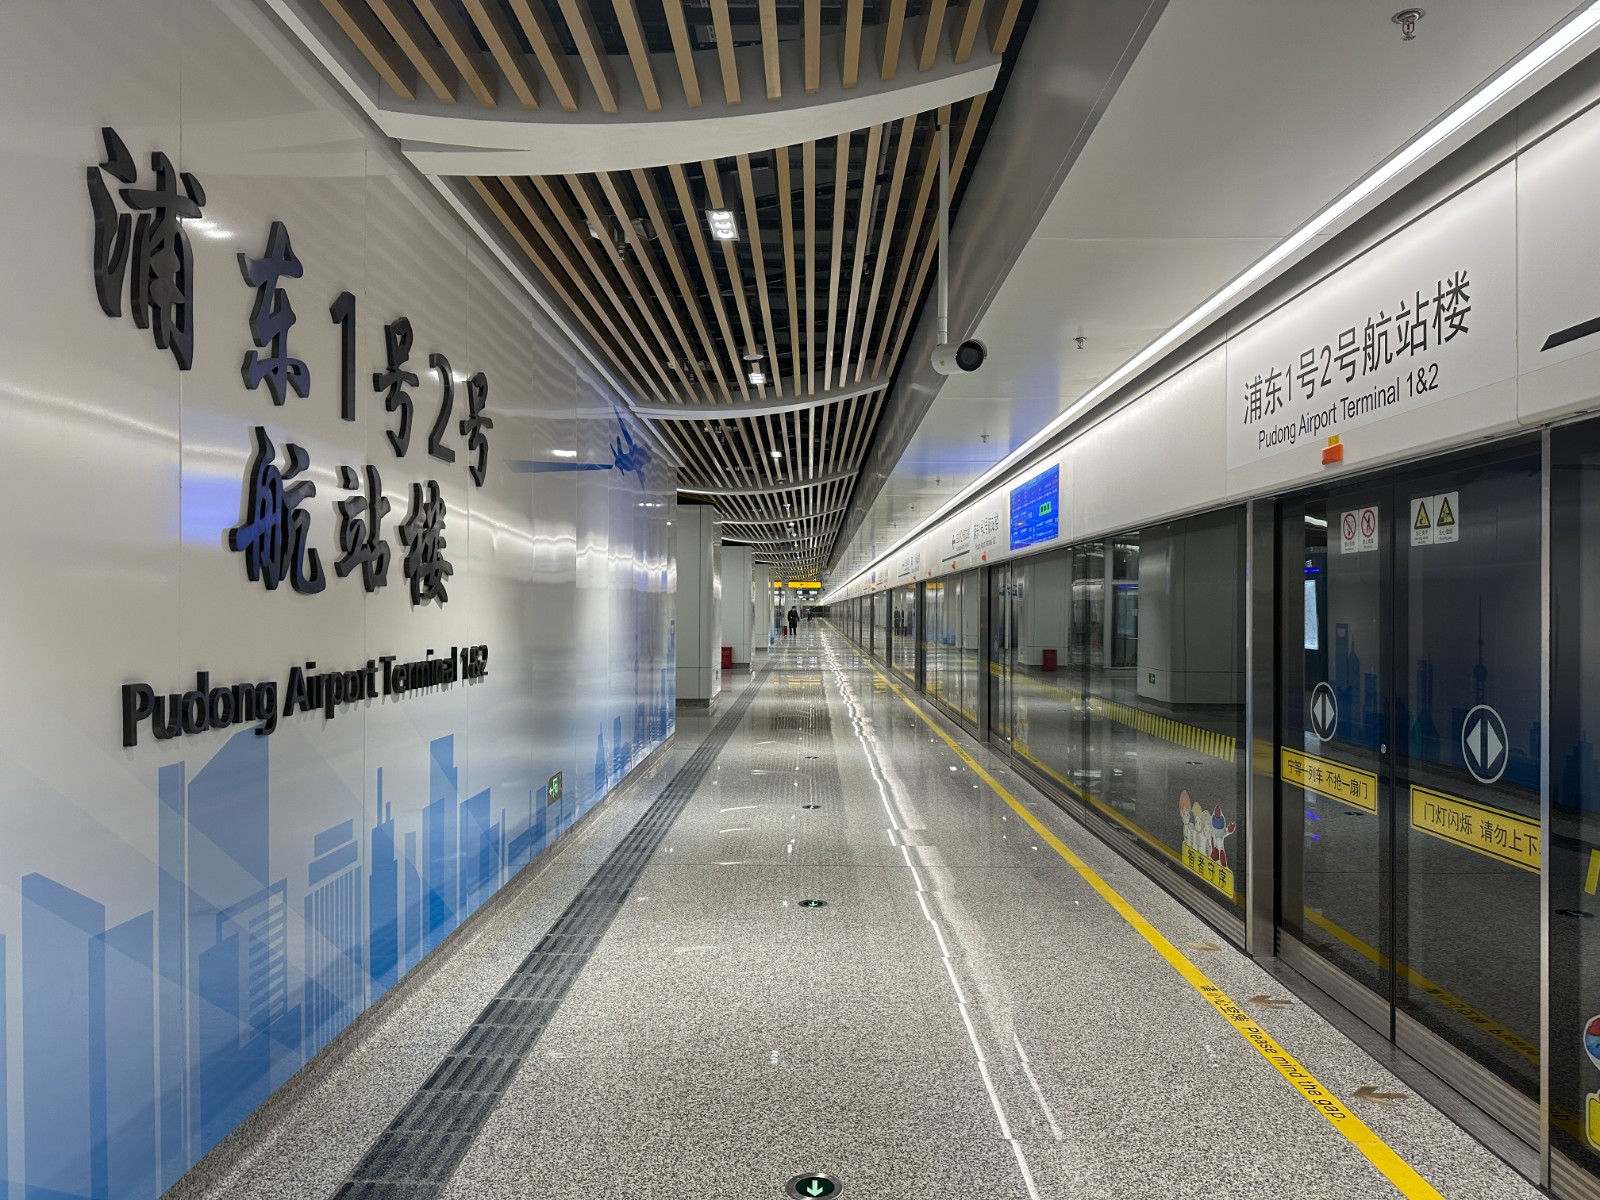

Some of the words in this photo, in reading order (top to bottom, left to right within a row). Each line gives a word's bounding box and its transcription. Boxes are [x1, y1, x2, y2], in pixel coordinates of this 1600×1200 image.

[87, 127, 494, 487] 浦东1号2号
[1243, 270, 1472, 424] 浦东1号2号航站楼
[1258, 424, 1296, 450] Pudong
[1298, 402, 1337, 437] Airport
[1340, 376, 1400, 421] Terminal
[1406, 362, 1439, 398] 1&2
[229, 426, 454, 606] 航站楼
[122, 671, 278, 747] Pudong
[283, 661, 379, 719] Airport
[379, 648, 458, 695] Terminal
[460, 645, 489, 680] 1&2
[1287, 759, 1324, 784] 宁等一列车
[1325, 770, 1368, 800] 不抢一扇门
[1188, 848, 1227, 889] 智者守序
[1423, 801, 1473, 836] 门灯闪烁
[1480, 818, 1541, 857] 请勿上下
[1242, 1026, 1278, 1054] Please
[1272, 1055, 1308, 1079] mind
[1297, 1080, 1322, 1097] the
[1312, 1098, 1346, 1122] gap.
